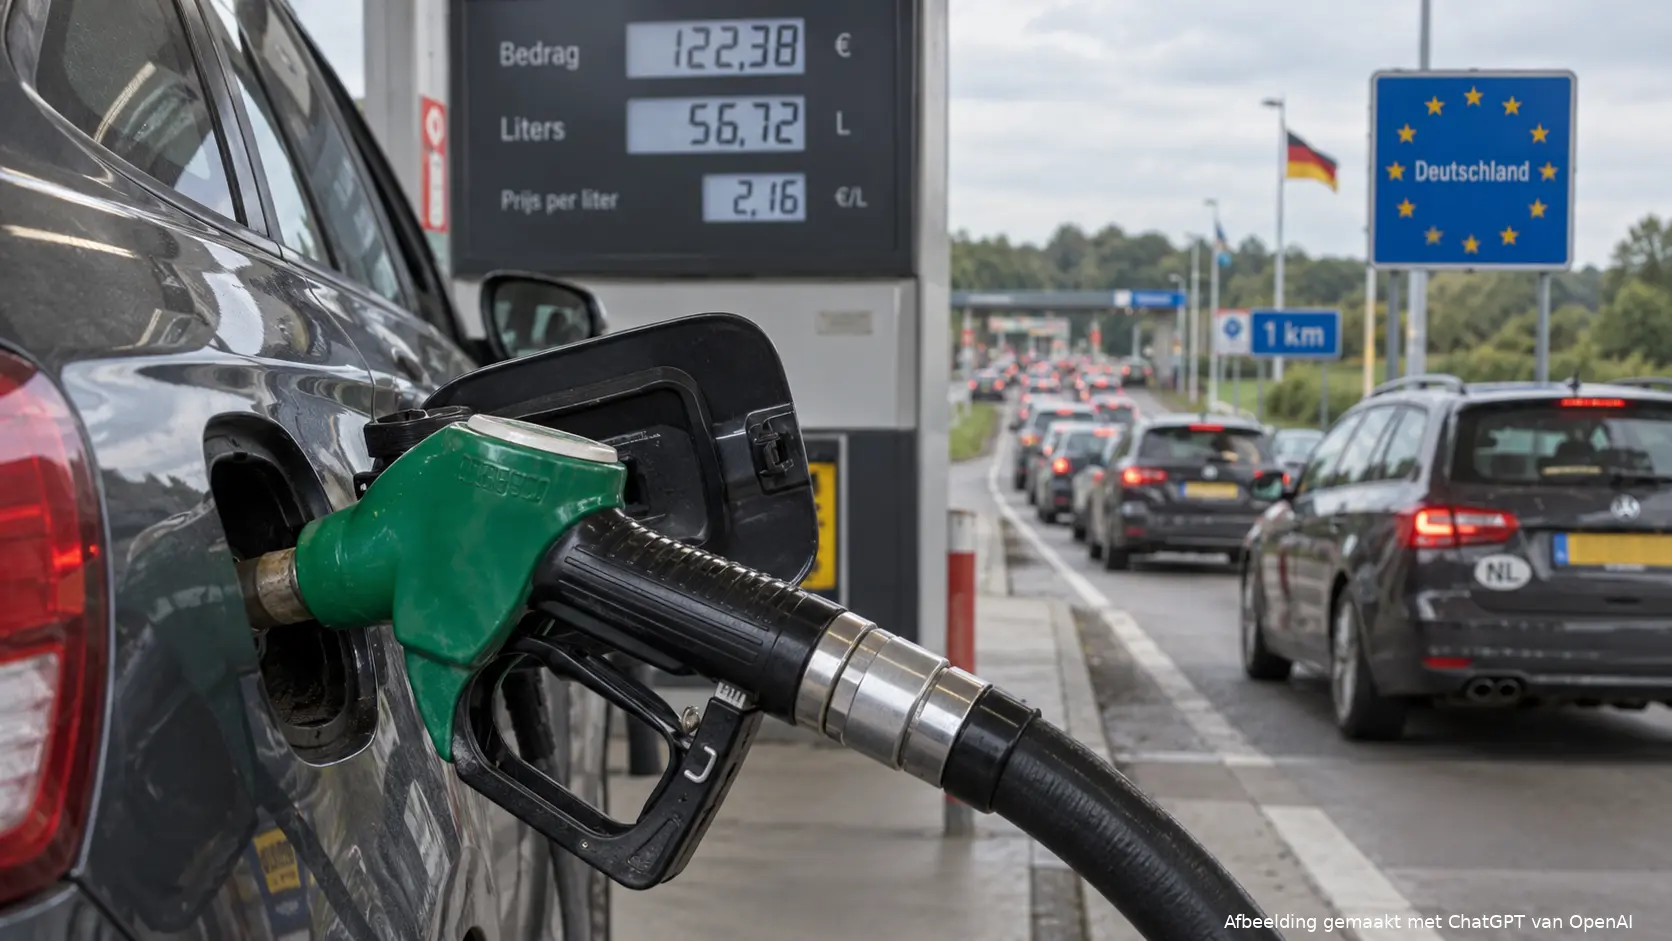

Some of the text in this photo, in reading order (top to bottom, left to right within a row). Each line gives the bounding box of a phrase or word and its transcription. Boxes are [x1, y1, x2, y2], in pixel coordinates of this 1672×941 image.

[500, 40, 580, 73] Bedrag
[673, 25, 799, 73] 122,38
[835, 32, 851, 58] €
[500, 116, 566, 142] Liters
[689, 101, 799, 148] 56,72
[836, 111, 851, 136] L
[1414, 159, 1530, 183] Deutschland
[501, 188, 618, 214] Prijs per liter
[733, 179, 799, 218] 2,16
[834, 186, 868, 208] €/L
[1263, 320, 1325, 348] 1 km
[1486, 562, 1520, 583] NL
